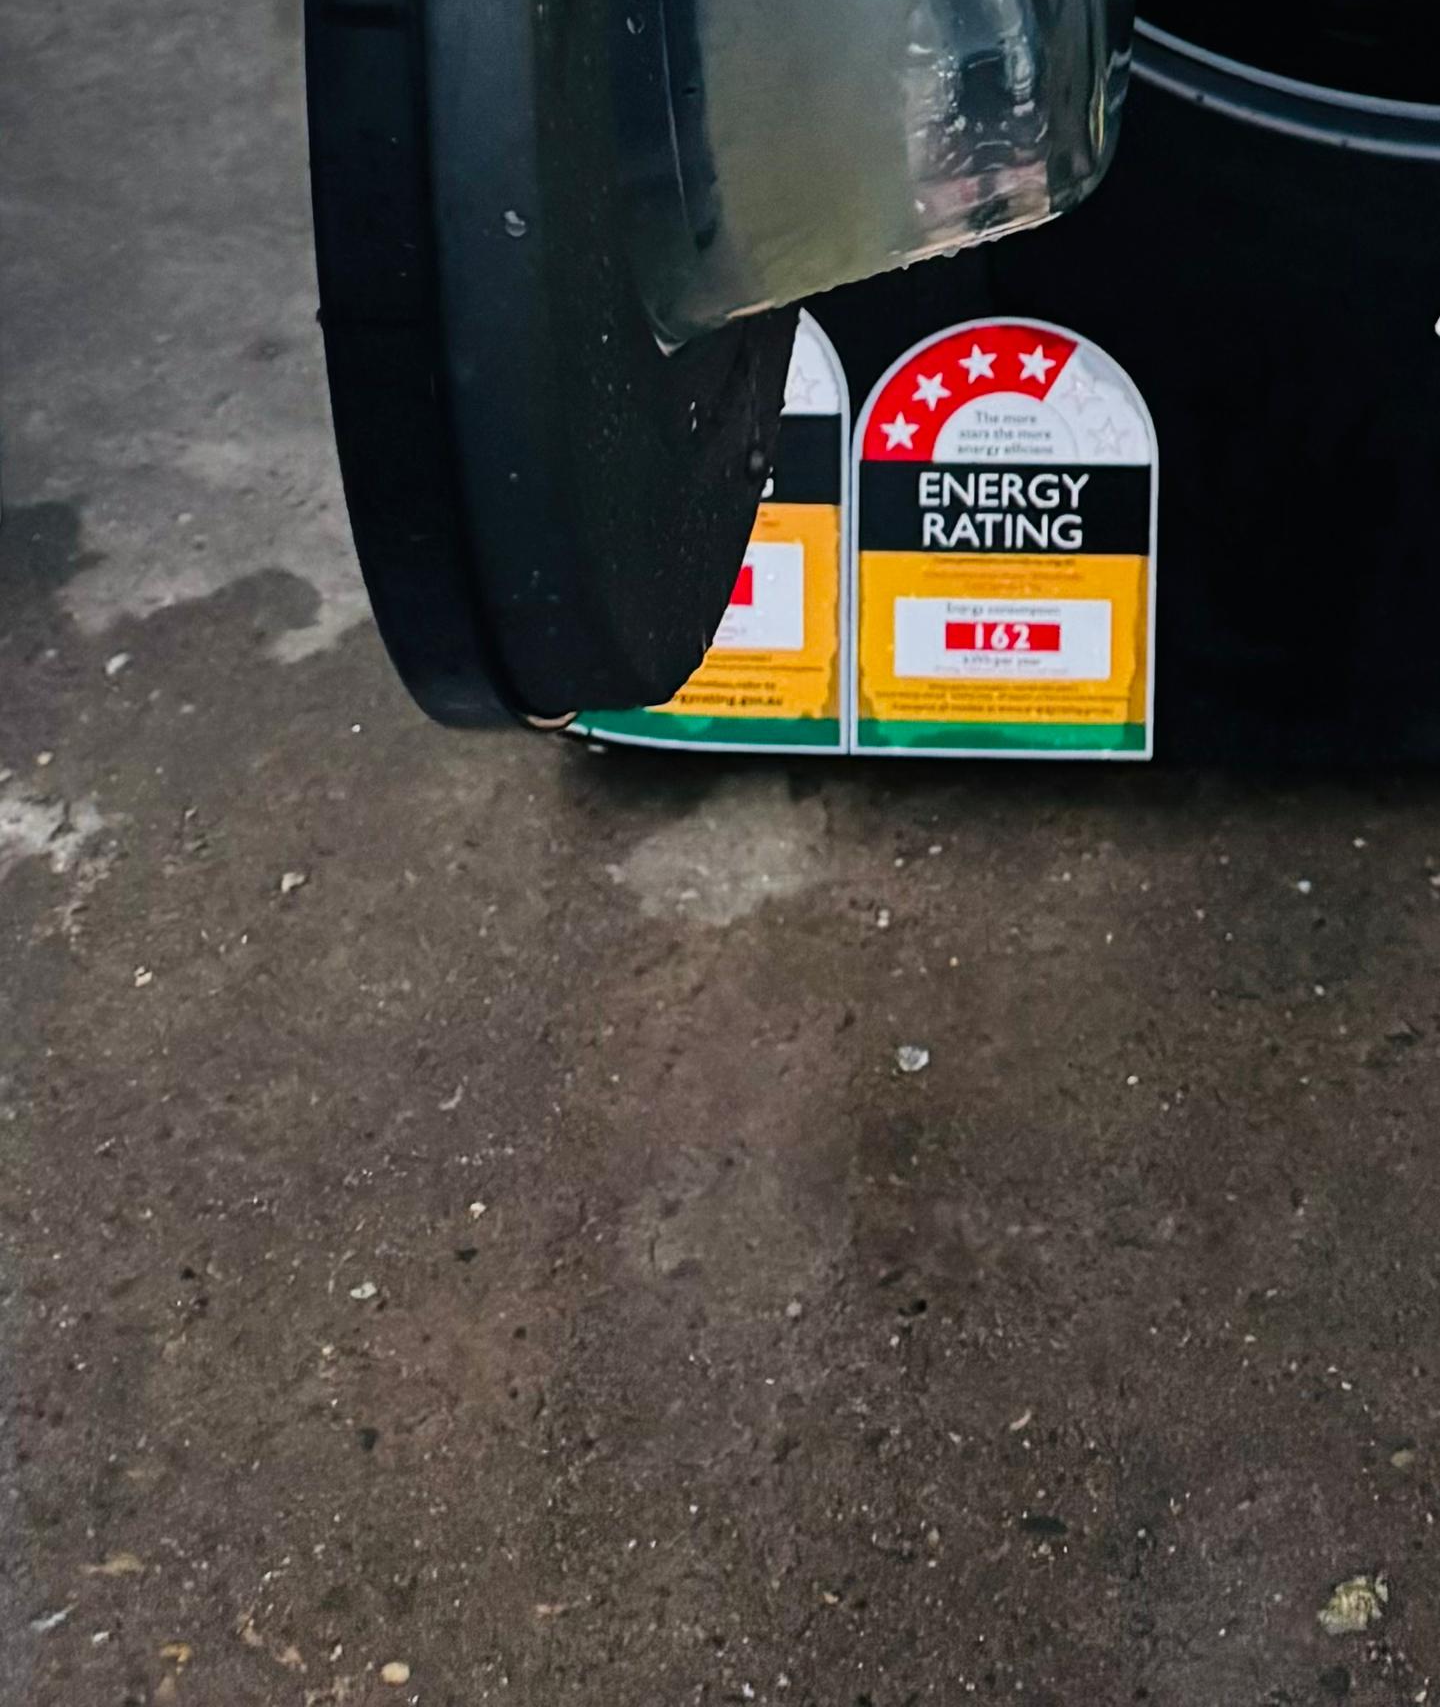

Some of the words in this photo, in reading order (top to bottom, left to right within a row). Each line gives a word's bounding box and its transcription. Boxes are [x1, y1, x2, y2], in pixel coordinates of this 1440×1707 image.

[976, 411, 999, 424] The
[1003, 413, 1037, 424] more
[959, 429, 990, 439] stars
[993, 428, 1013, 439] the
[1017, 430, 1051, 439] more
[957, 445, 1000, 457] energy
[1004, 444, 1054, 455] efficient
[918, 471, 1090, 509] ENERGY
[922, 512, 1083, 550] RATING
[974, 622, 1031, 650] 162
